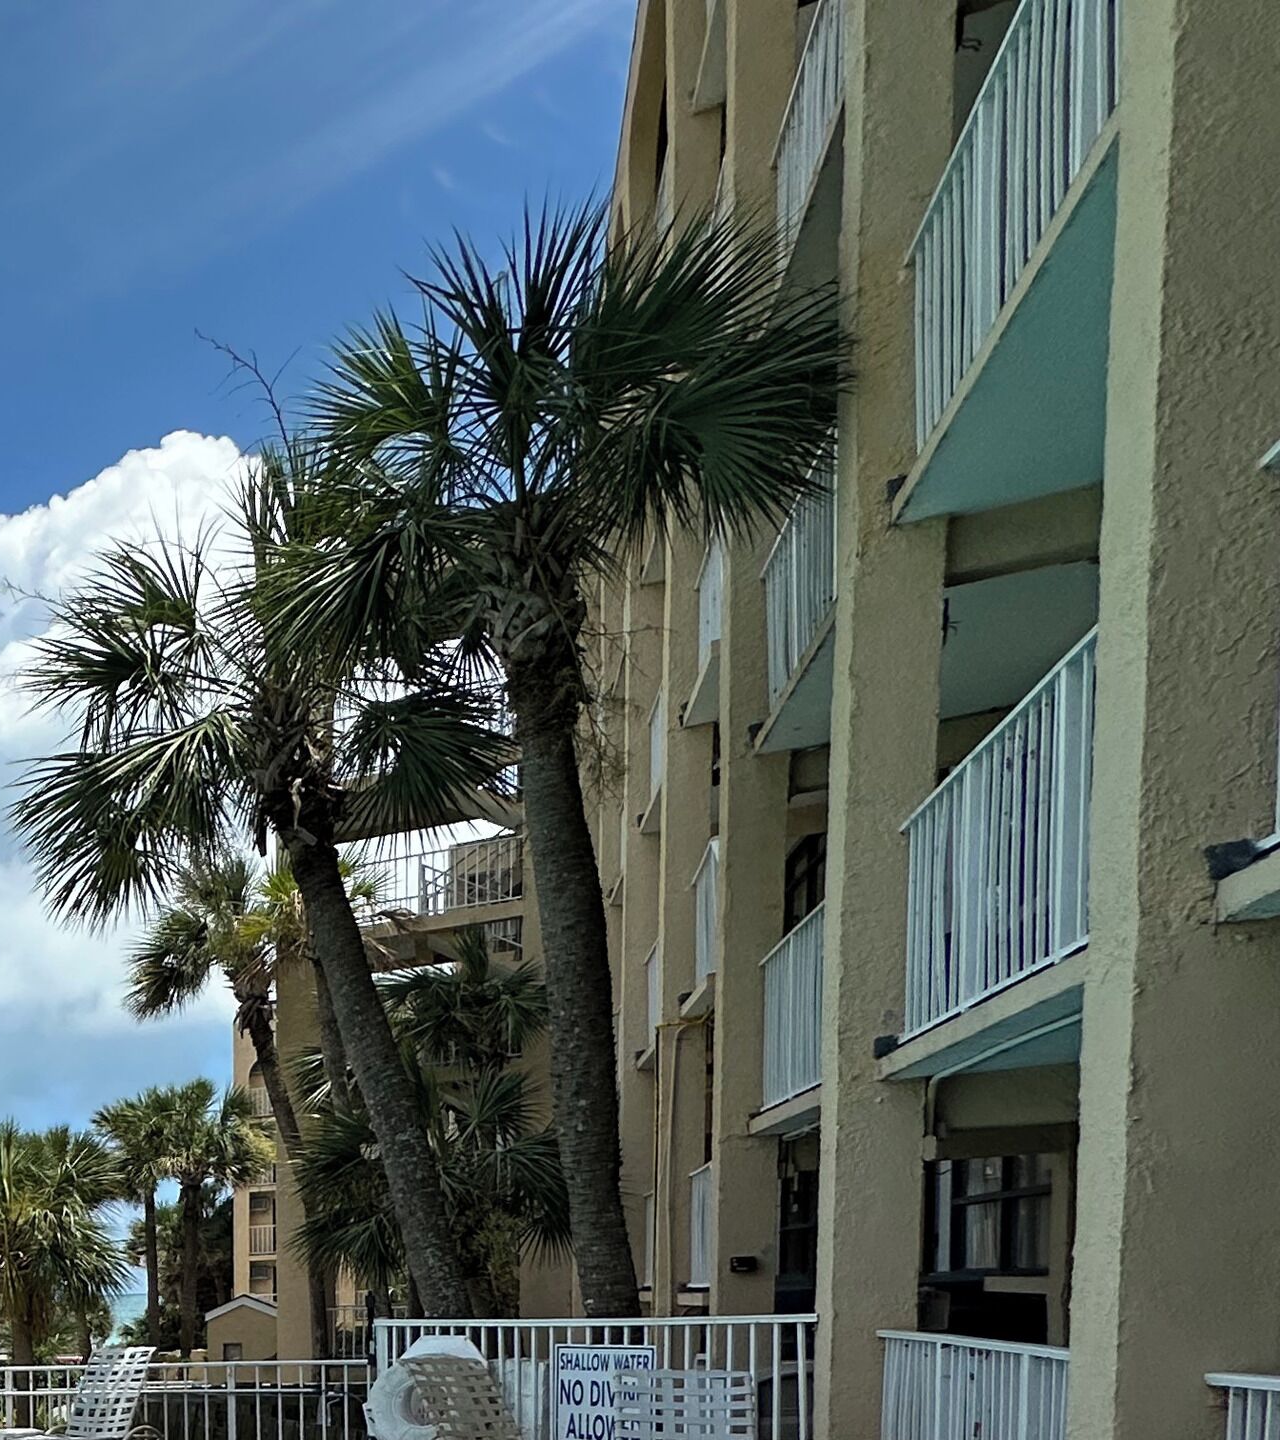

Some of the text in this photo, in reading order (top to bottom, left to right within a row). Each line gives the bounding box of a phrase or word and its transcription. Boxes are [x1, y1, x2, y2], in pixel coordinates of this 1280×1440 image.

[560, 1353, 650, 1371] SHALLOW WATER
[560, 1379, 583, 1405] NO
